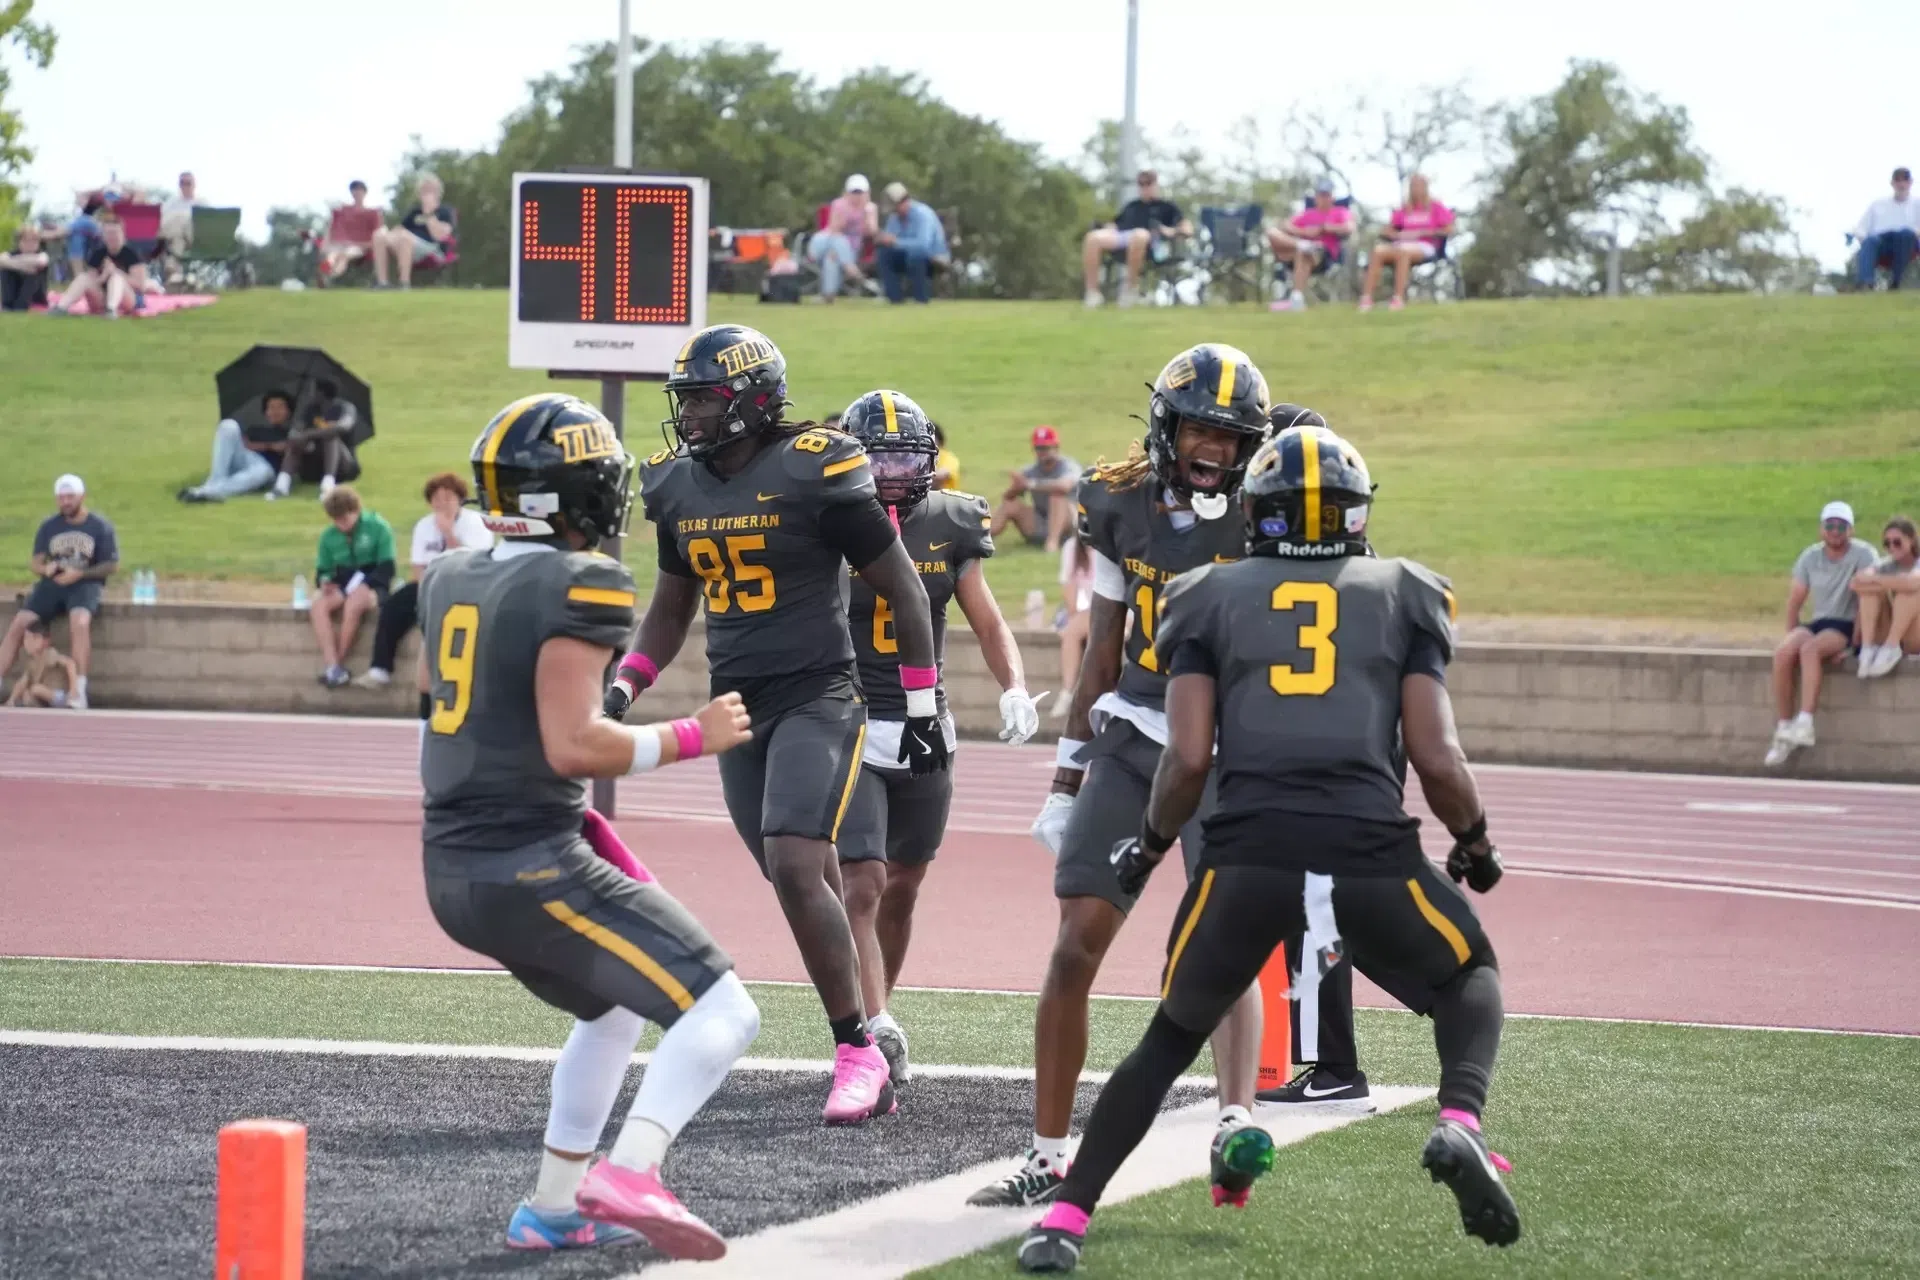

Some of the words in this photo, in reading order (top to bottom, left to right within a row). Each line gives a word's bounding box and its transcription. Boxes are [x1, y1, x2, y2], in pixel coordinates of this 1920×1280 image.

[524, 187, 688, 322] 40
[678, 517, 708, 533] TEXAS
[712, 514, 780, 531] LUTHERAN
[1277, 541, 1347, 557] Riddell
[687, 533, 777, 614] 85
[430, 602, 480, 736] 9
[1268, 580, 1339, 697] 3
